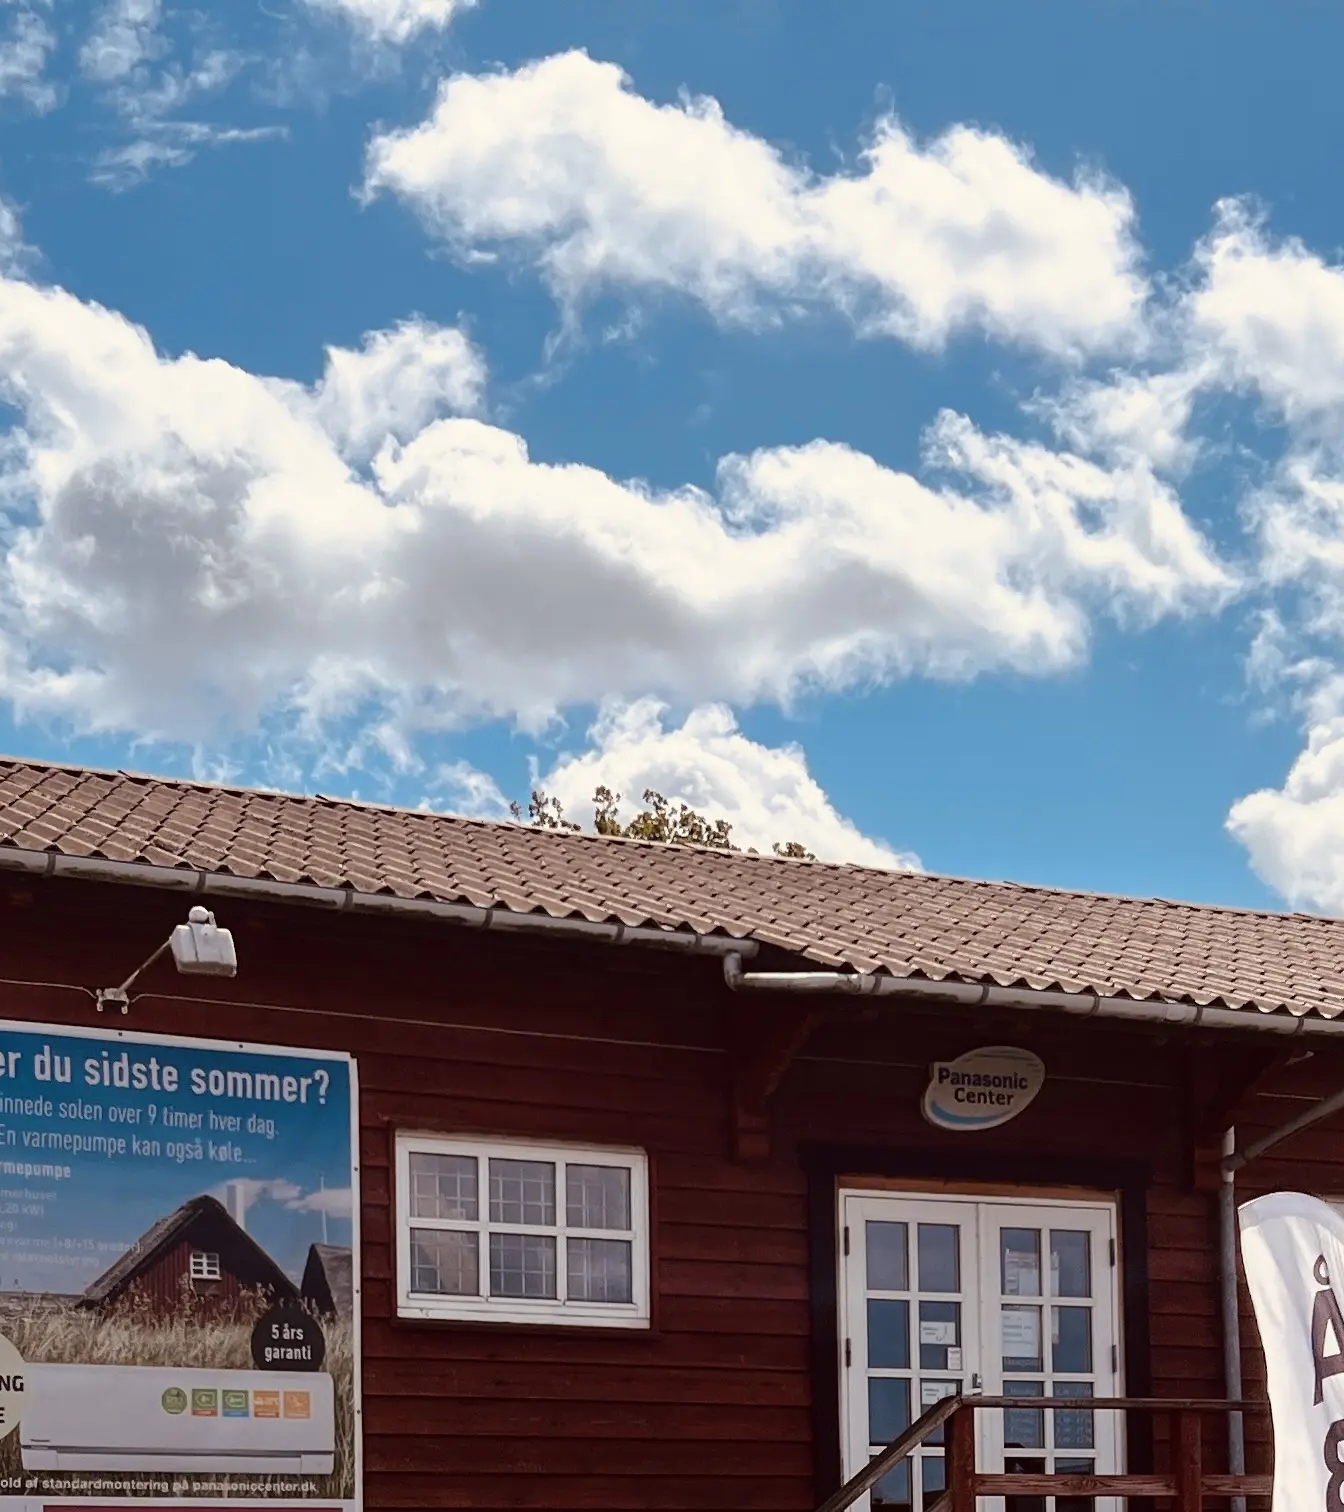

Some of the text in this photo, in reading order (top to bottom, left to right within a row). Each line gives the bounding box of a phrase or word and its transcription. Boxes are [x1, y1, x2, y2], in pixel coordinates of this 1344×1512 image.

[34, 1044, 72, 1083] du
[84, 1050, 179, 1093] sidste
[190, 1067, 330, 1105] sommer?
[937, 1066, 1029, 1090] Panasonic
[954, 1087, 1015, 1106] Center
[59, 1098, 103, 1121] solen
[108, 1106, 143, 1125] over
[147, 1103, 157, 1125] 9
[162, 1105, 204, 1130] timer
[209, 1109, 242, 1131] hver
[247, 1112, 280, 1140] dag.
[22, 1130, 126, 1156] varmepumpe
[132, 1134, 161, 1157] kan
[166, 1137, 204, 1164] også
[208, 1139, 257, 1164] køle...
[271, 1322, 304, 1341] 5 års
[264, 1344, 312, 1363] garanti
[24, 1476, 39, 1489] af
[41, 1476, 169, 1493] standardmontering
[172, 1478, 189, 1493] på
